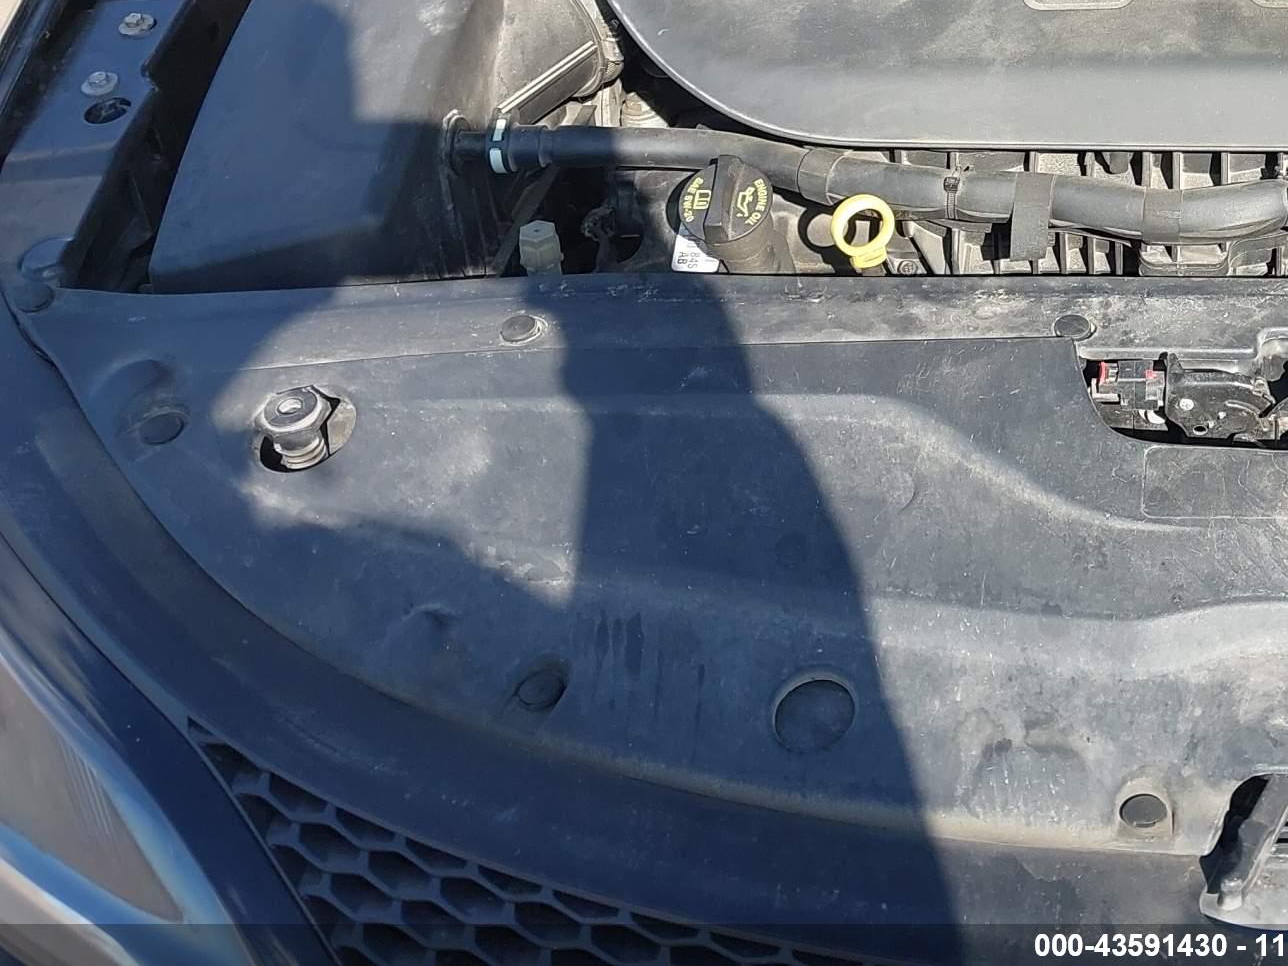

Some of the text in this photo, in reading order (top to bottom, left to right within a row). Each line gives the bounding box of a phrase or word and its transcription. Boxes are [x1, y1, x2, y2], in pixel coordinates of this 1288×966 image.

[682, 177, 704, 222] SAE 5W-20
[744, 178, 768, 226] ENGINE OIL
